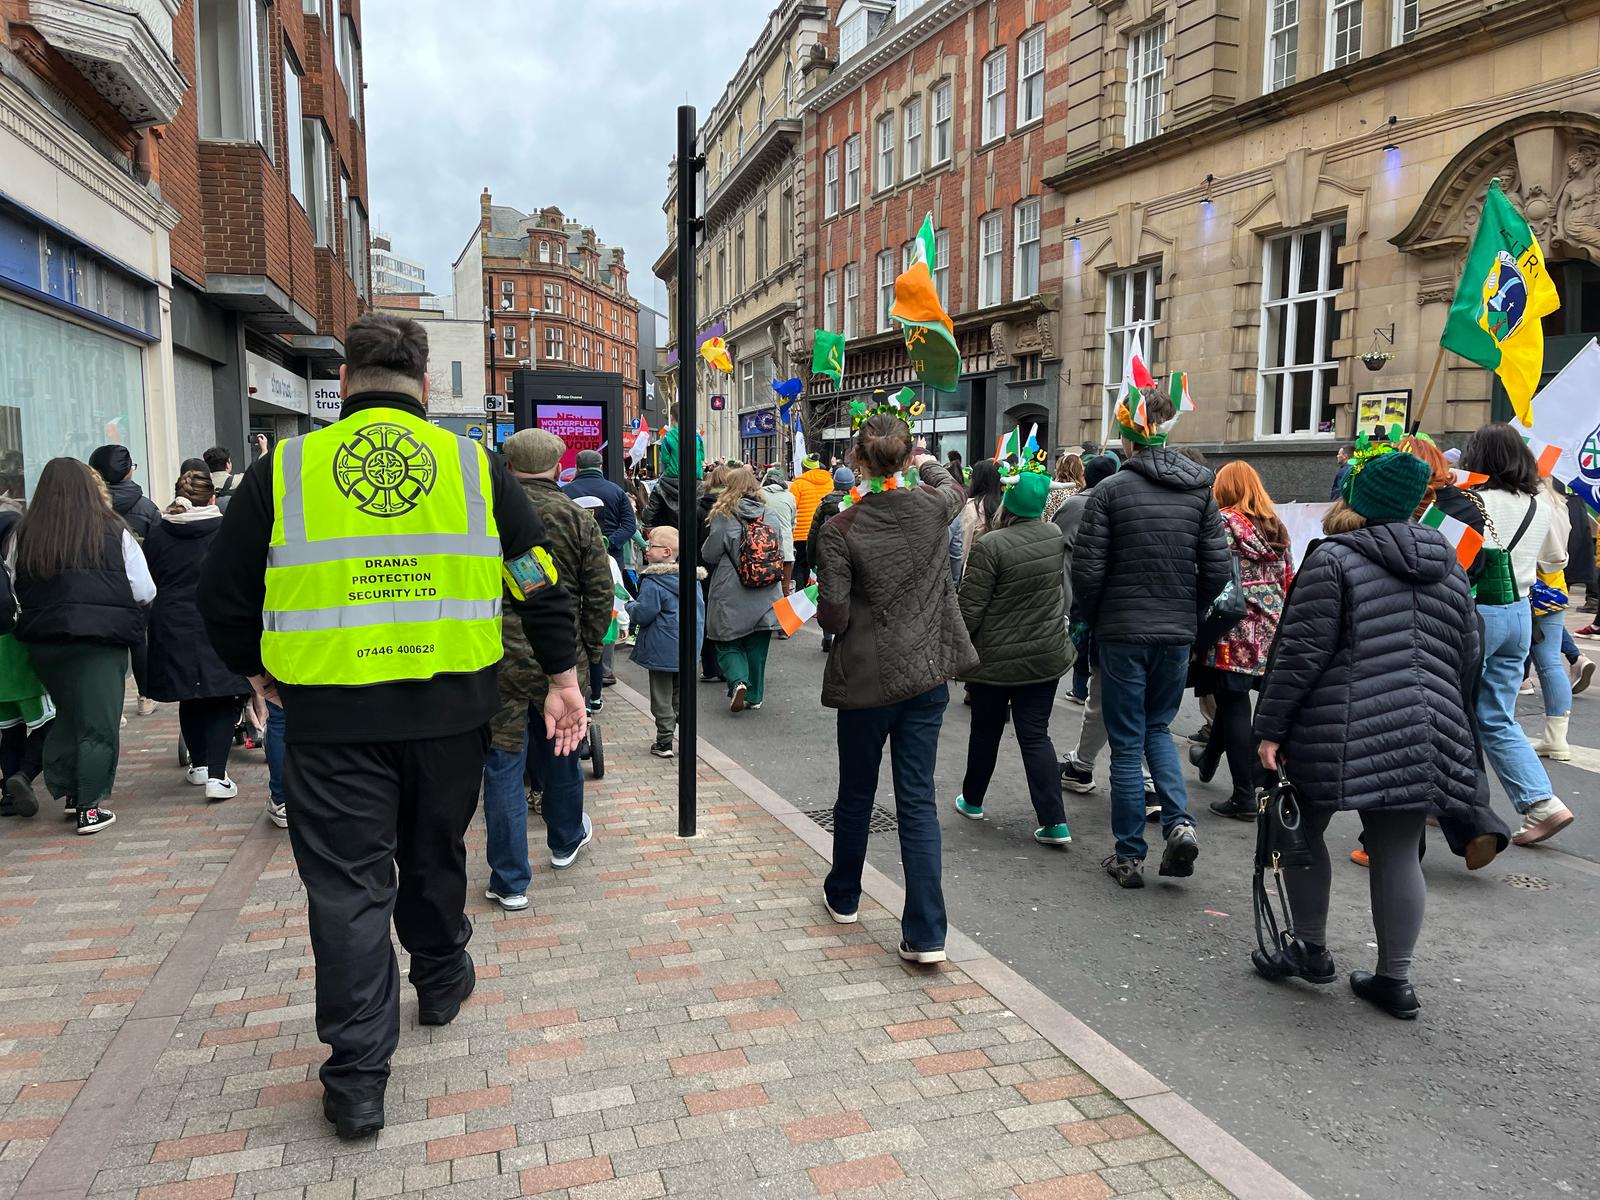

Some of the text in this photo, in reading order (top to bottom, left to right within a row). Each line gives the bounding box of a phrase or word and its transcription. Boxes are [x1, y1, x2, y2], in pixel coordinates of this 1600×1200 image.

[1023, 388, 1028, 401] 8
[566, 442, 599, 450] VOUR
[365, 557, 418, 569] DRANAS
[352, 572, 431, 585] PROTECTION
[348, 587, 437, 601] SECURITY LTD
[357, 643, 435, 658] 07446 400628
